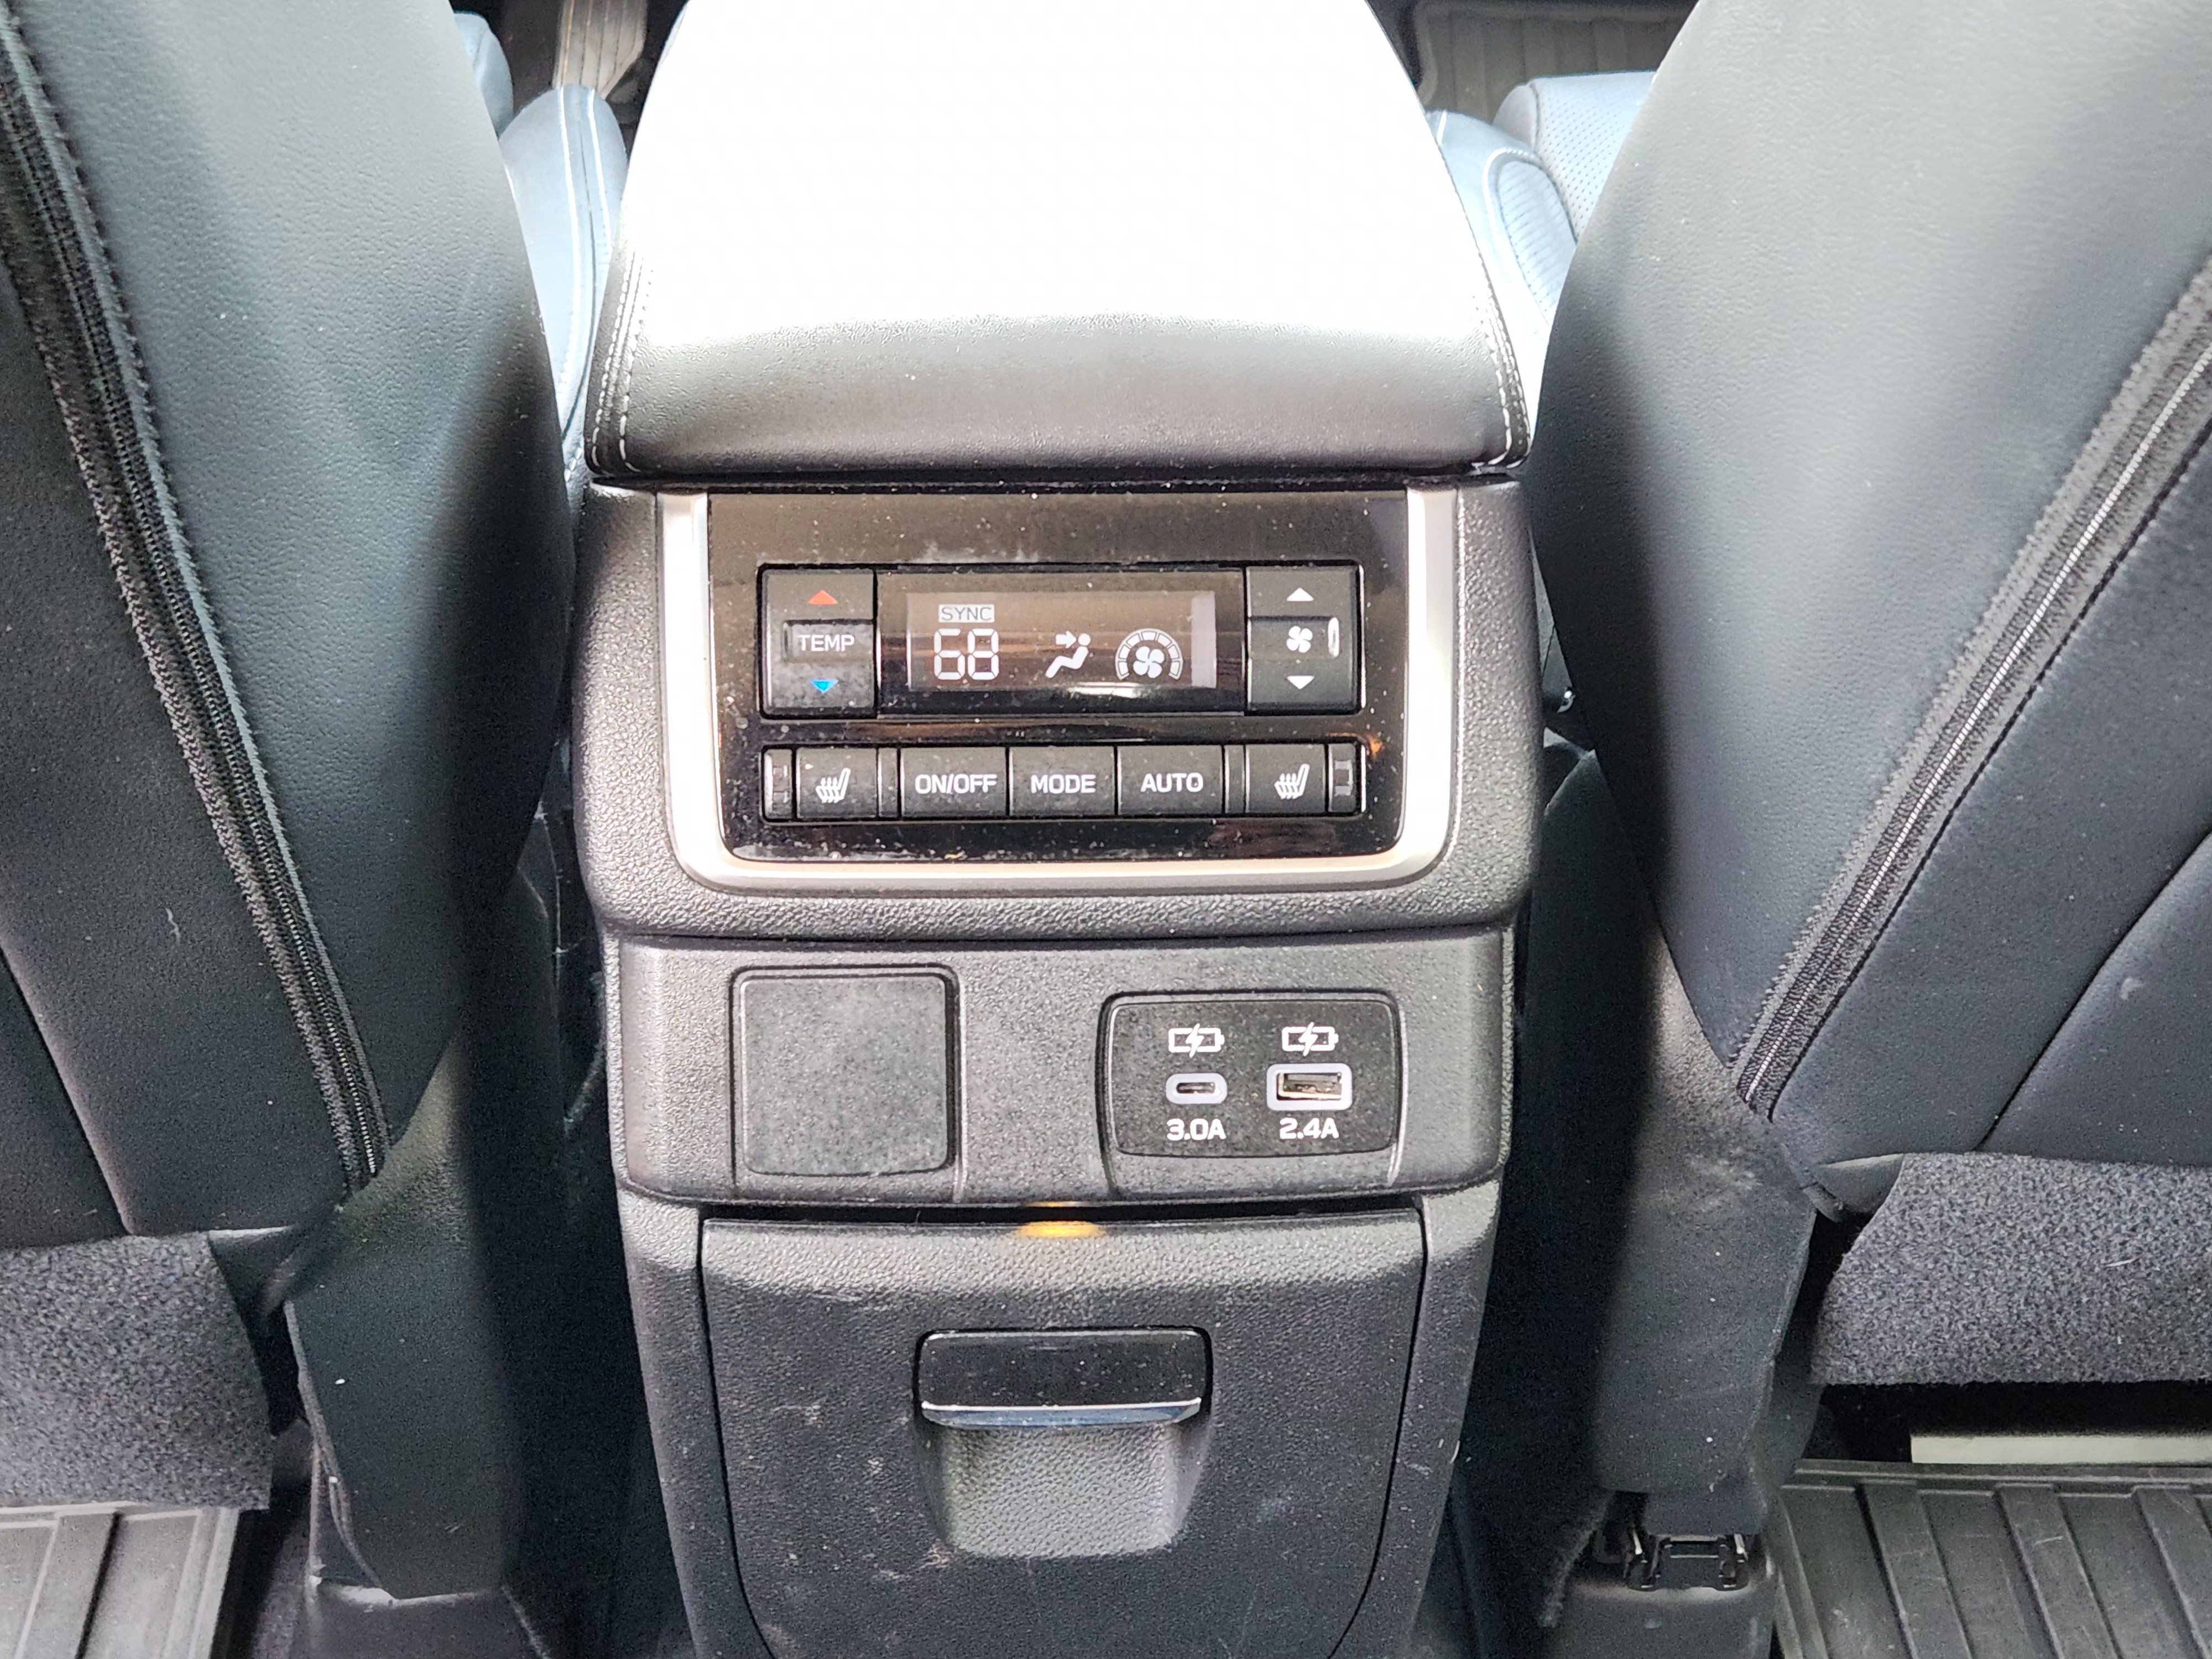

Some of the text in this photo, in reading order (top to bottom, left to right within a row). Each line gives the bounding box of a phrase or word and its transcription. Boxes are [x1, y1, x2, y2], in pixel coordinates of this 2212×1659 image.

[942, 606, 993, 622] SYNC
[798, 634, 855, 653] TEMP
[933, 628, 999, 681] 68
[915, 774, 997, 795] ON/OFF
[1031, 774, 1096, 794] MODE
[1141, 773, 1204, 792] AUTO
[1166, 1118, 1227, 1141] 3.0A
[1279, 1118, 1339, 1139] 2.4A
